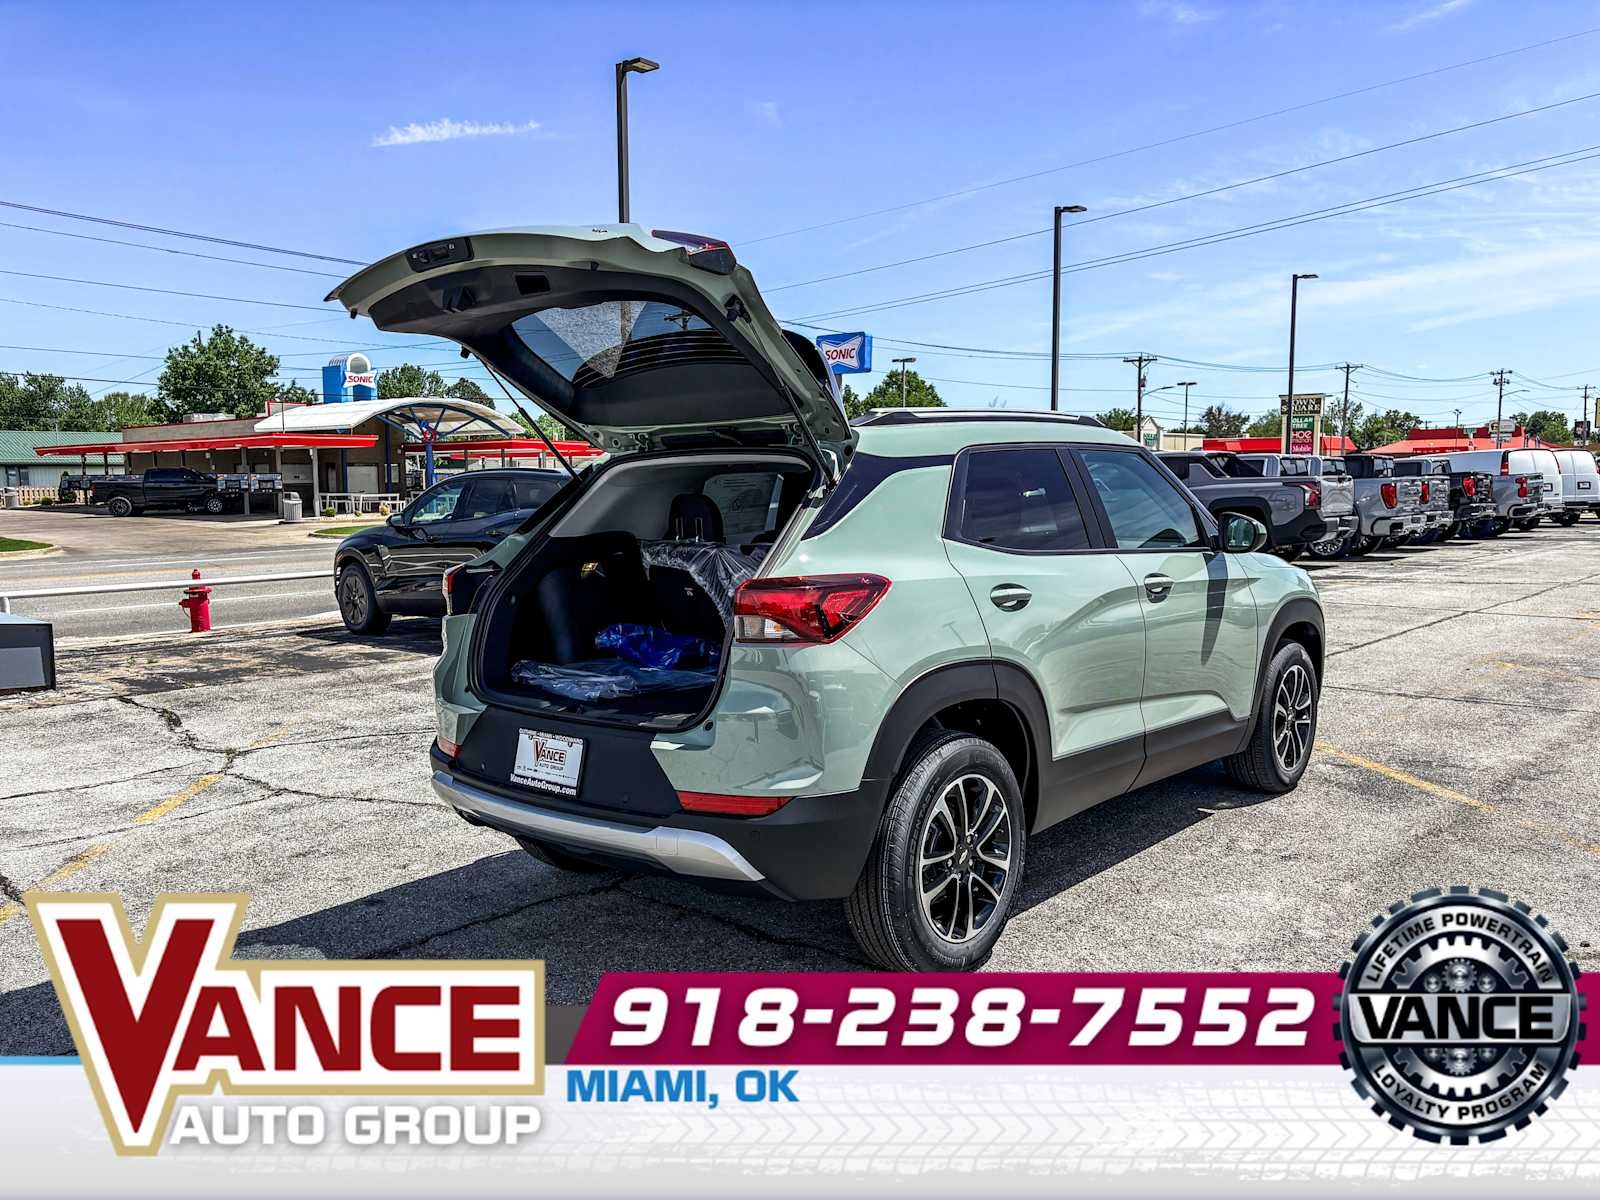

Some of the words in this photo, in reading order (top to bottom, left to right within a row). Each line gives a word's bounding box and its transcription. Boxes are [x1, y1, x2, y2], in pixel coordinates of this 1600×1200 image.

[825, 347, 856, 361] SONIC
[347, 375, 374, 384] SONIC
[534, 739, 566, 763] VANCE
[510, 773, 577, 796] VanceAutoGroup.com
